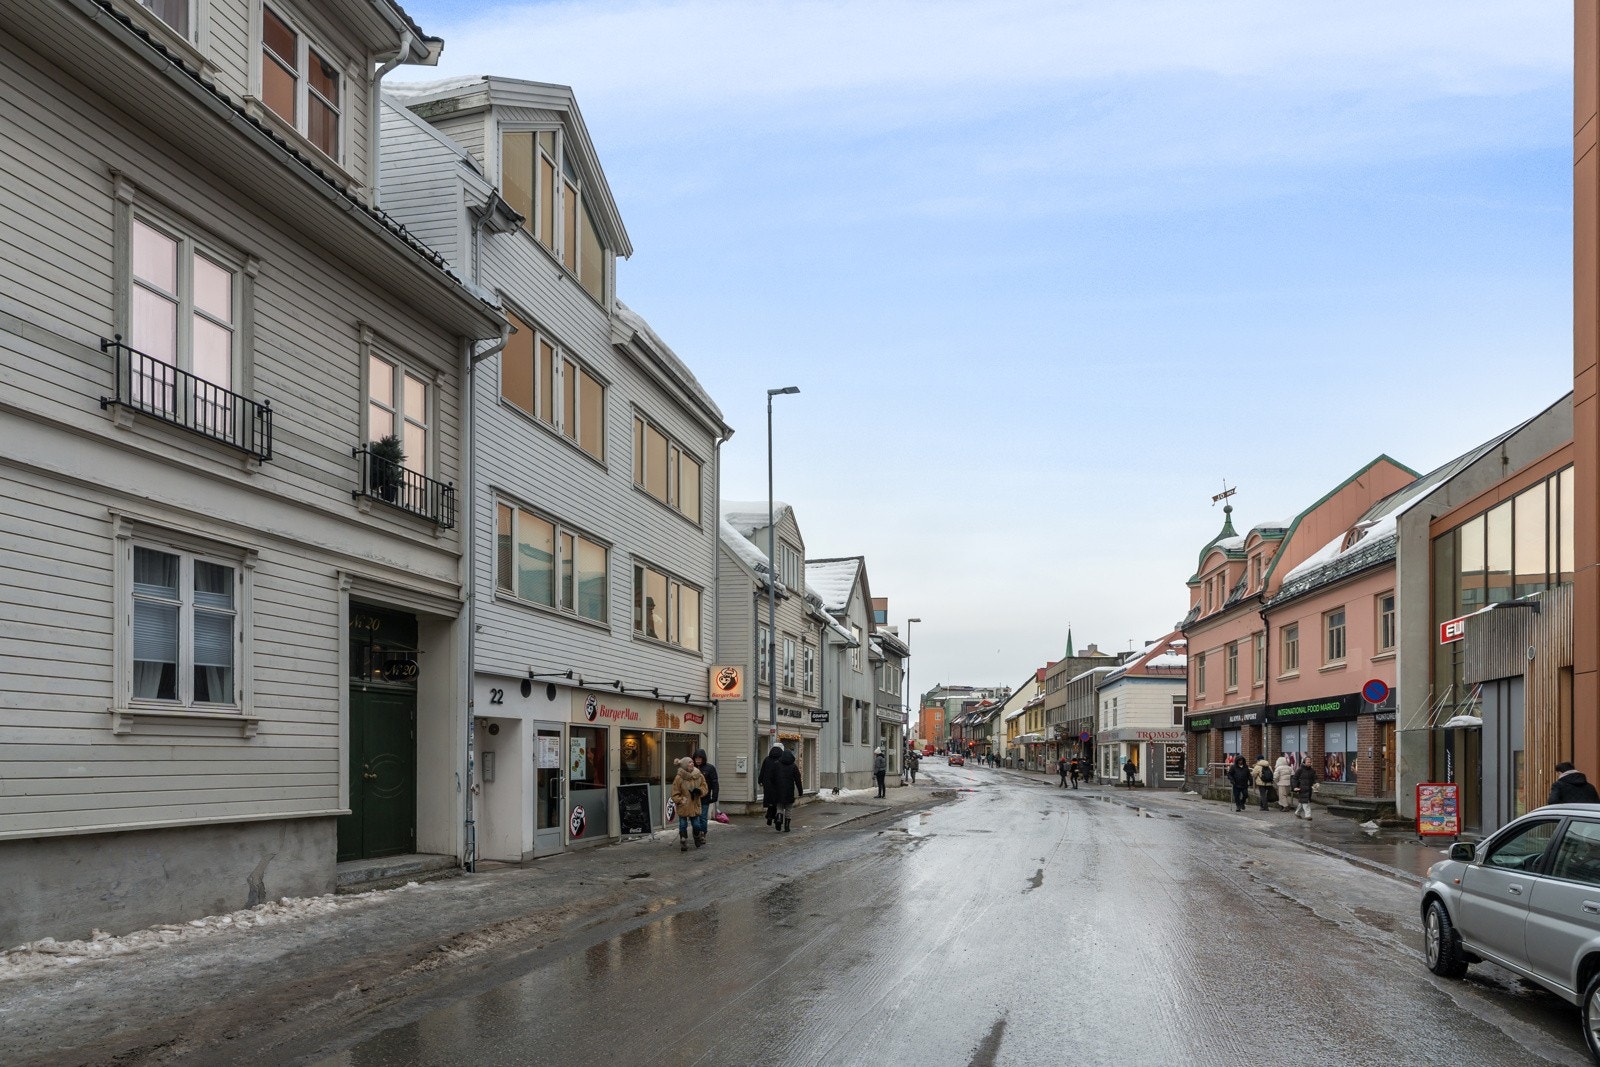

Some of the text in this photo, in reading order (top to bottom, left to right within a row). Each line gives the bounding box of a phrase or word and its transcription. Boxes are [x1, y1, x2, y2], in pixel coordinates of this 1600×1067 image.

[403, 664, 417, 676] 20
[489, 688, 504, 705] 22
[600, 704, 639, 722] BurgerMan
[1277, 706, 1307, 717] INTERNATIONAL
[1307, 704, 1320, 713] FOOD
[1136, 731, 1179, 739] TROMSØ
